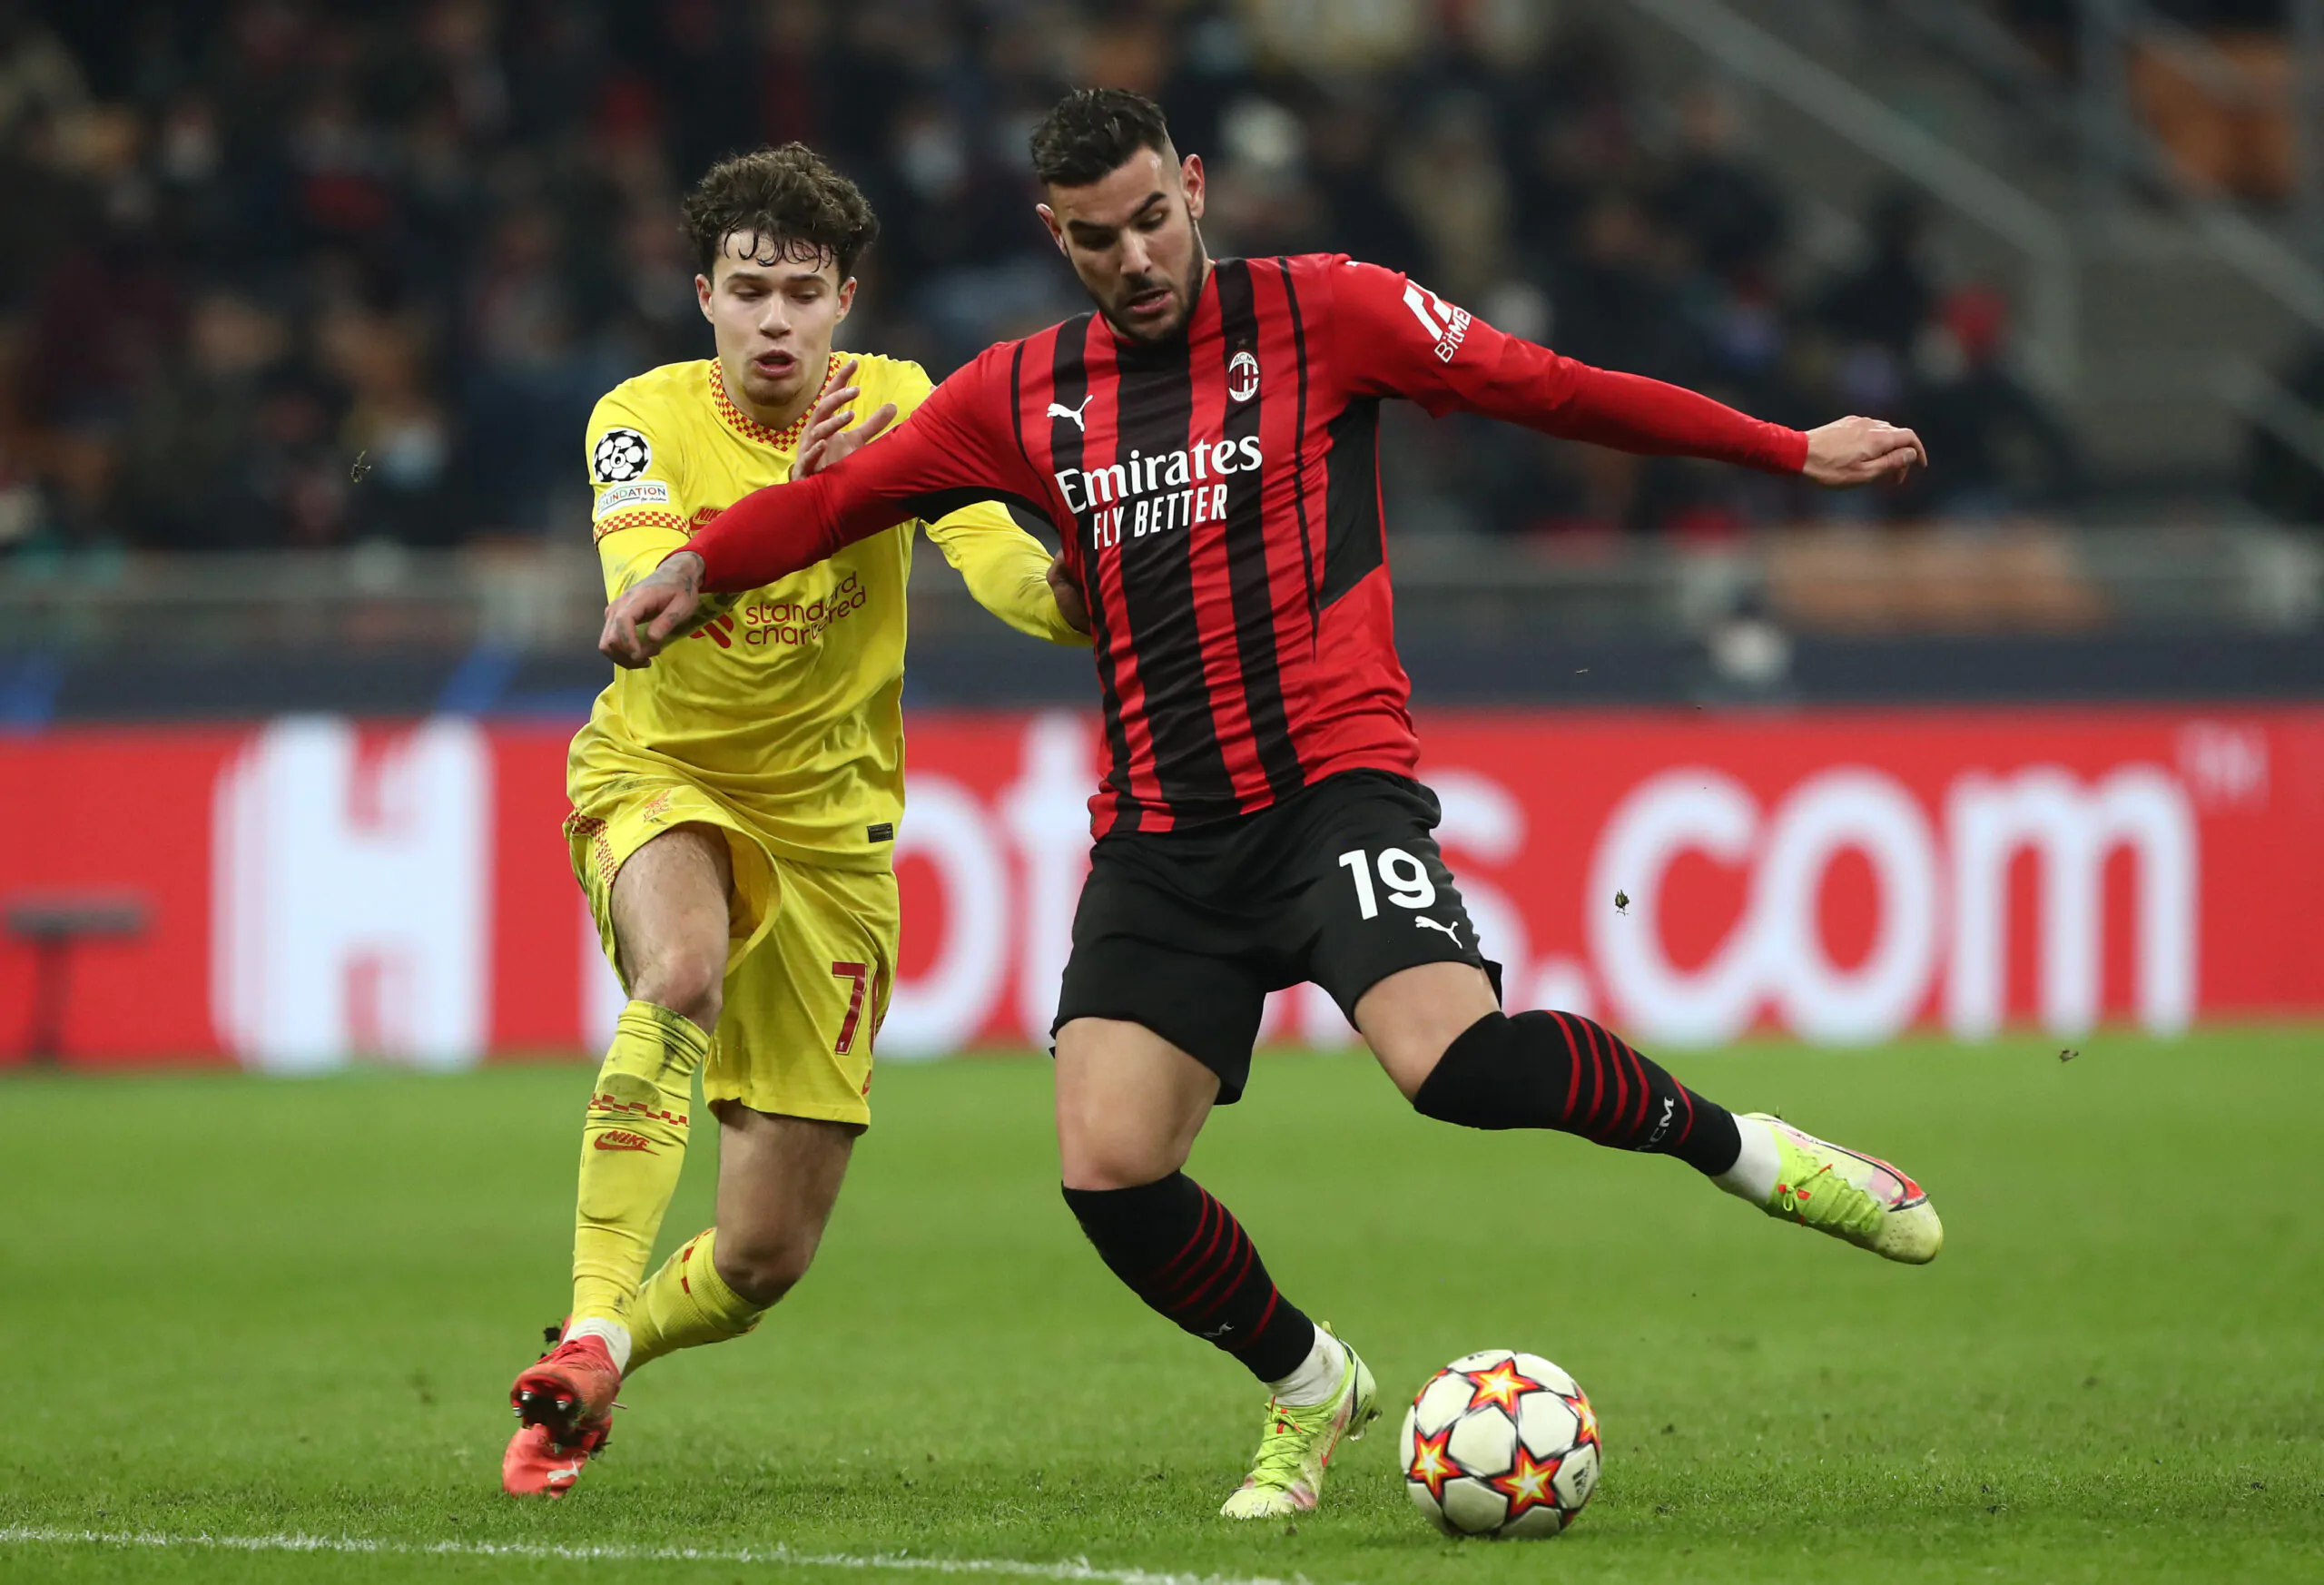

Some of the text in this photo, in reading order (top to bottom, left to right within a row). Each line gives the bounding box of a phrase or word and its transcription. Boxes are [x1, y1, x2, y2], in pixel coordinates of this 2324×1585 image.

[1234, 353, 1254, 365] ACM
[598, 487, 667, 508] OUNDATION
[1054, 436, 1263, 515] Emirates
[693, 507, 724, 522] NIK
[1093, 484, 1228, 550] FLY BETTER
[745, 571, 857, 625] standard
[745, 586, 866, 645] chartered
[1338, 847, 1436, 920] 19
[604, 1130, 650, 1147] NIKE
